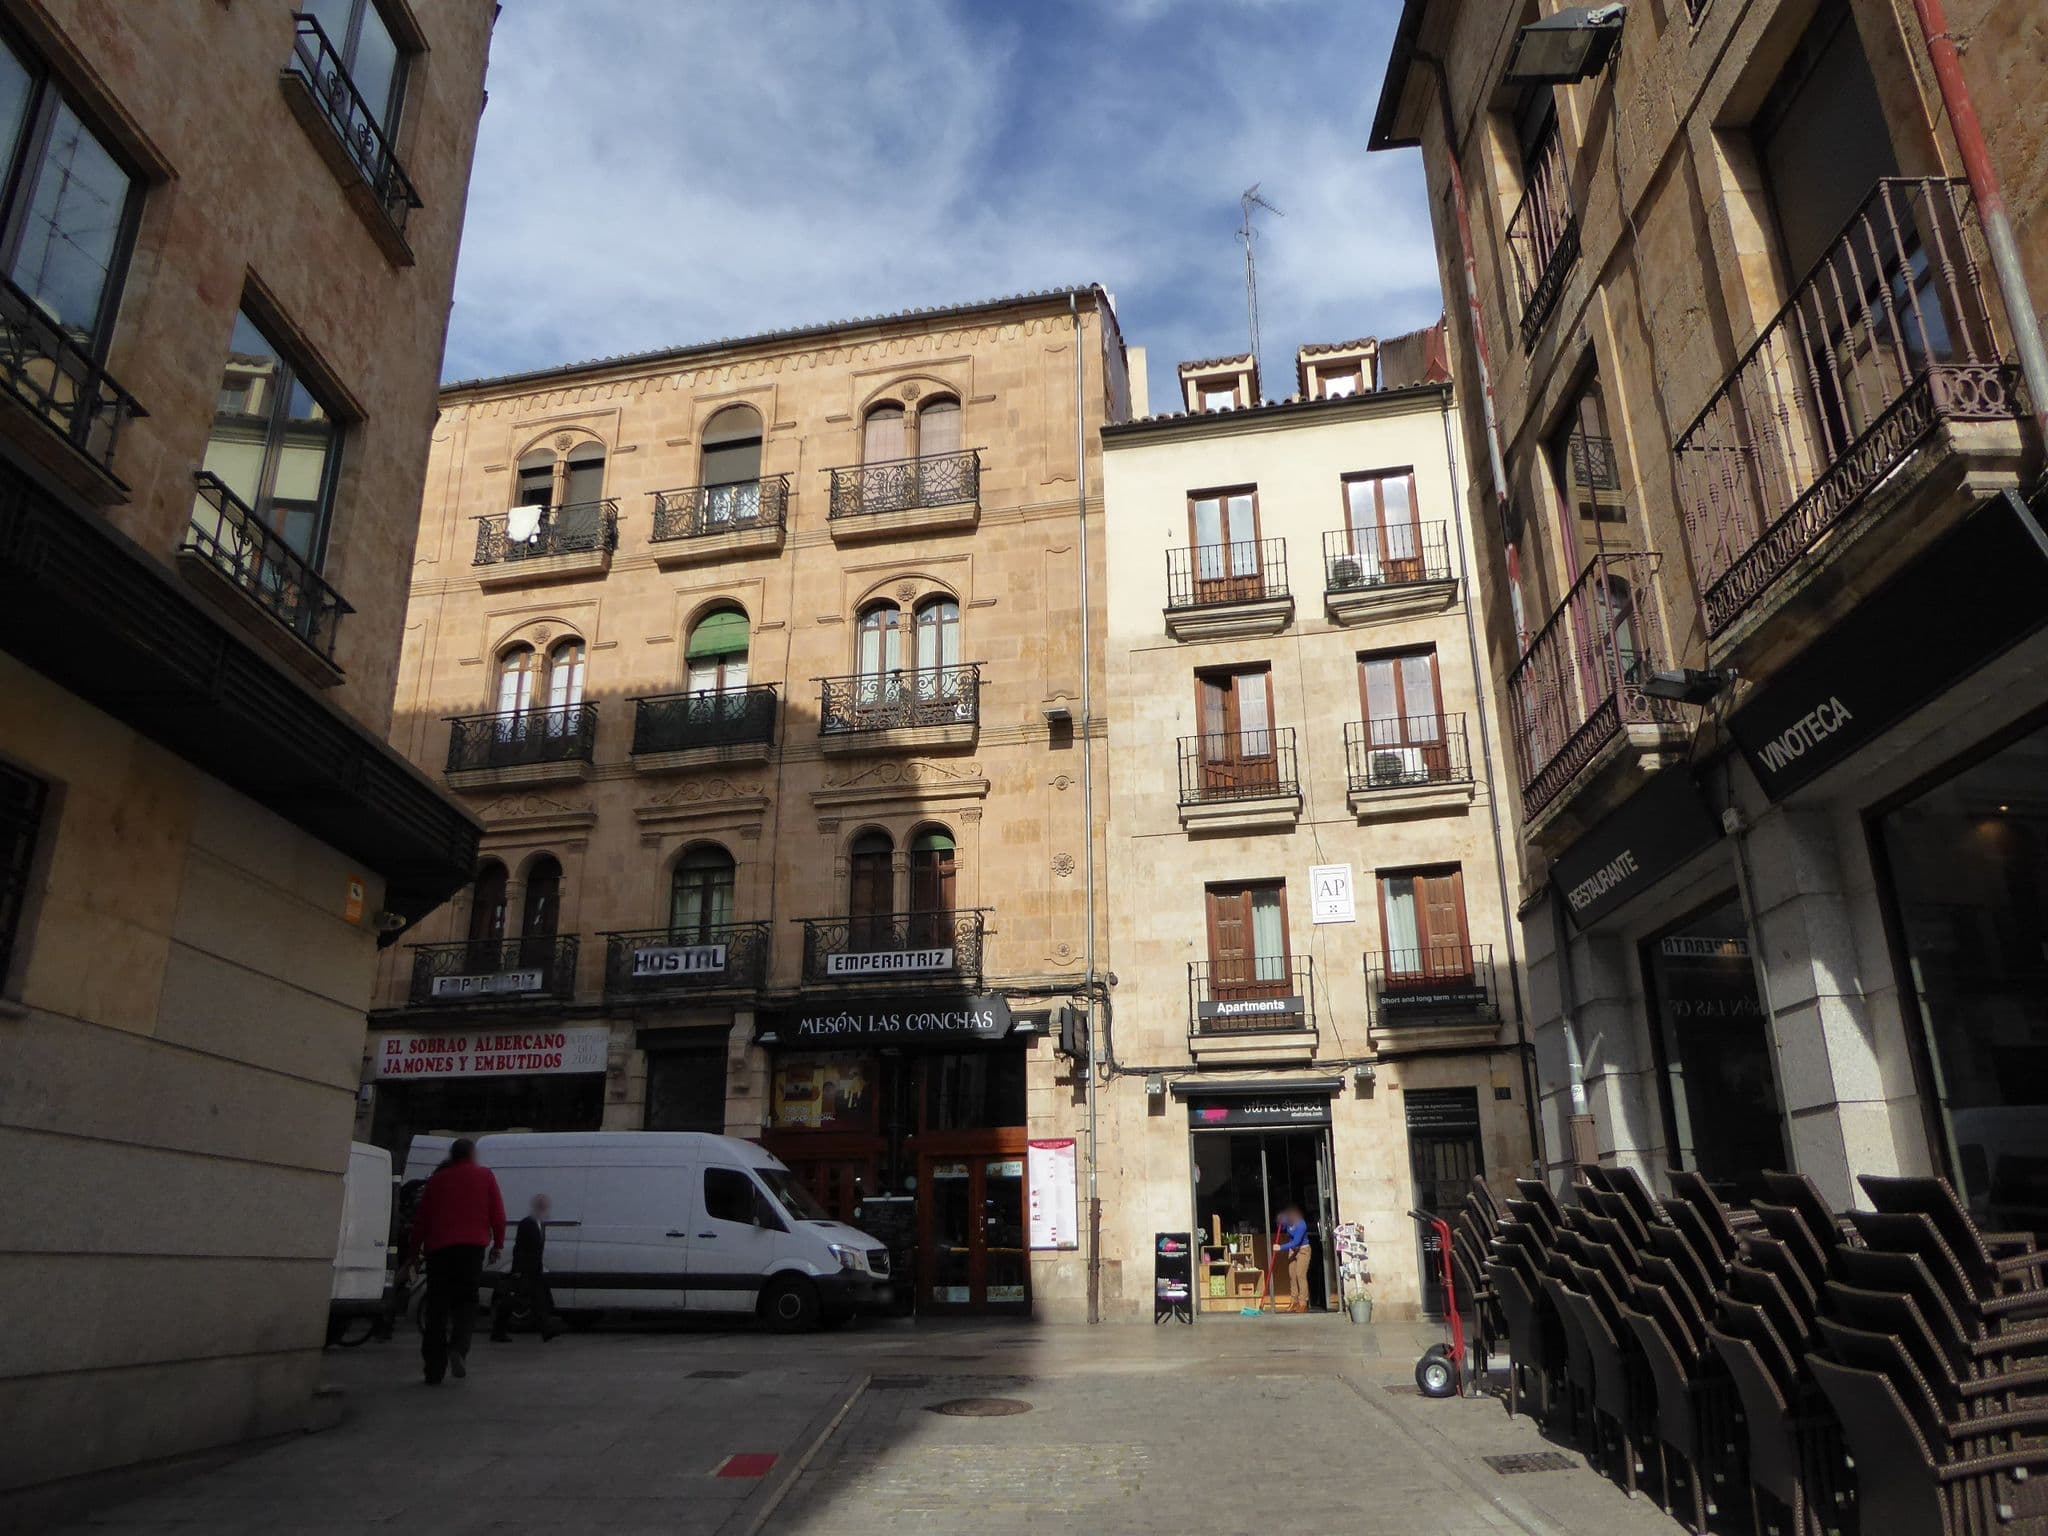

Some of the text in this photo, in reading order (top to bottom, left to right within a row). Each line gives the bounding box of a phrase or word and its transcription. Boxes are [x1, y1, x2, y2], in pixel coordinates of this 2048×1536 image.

[1757, 696, 1852, 773] VINOTECA
[1319, 878, 1346, 897] AP
[1567, 848, 1640, 912] RESTAURANTE
[633, 948, 724, 973] HOSTAL
[834, 951, 946, 971] EMPERATRIZ
[1217, 999, 1286, 1015] Apartments
[1380, 997, 1401, 1005] Short
[1401, 996, 1416, 1004] and
[1416, 995, 1433, 1004] long
[1433, 994, 1450, 1002] term
[798, 1010, 994, 1035] MESÓN LAS CONCHAS
[386, 1039, 404, 1055] EL
[409, 1037, 468, 1055] SOBRAO
[473, 1033, 566, 1053] ALBERCANO
[383, 1052, 563, 1074] JAMONES Y EMBUTIDOS
